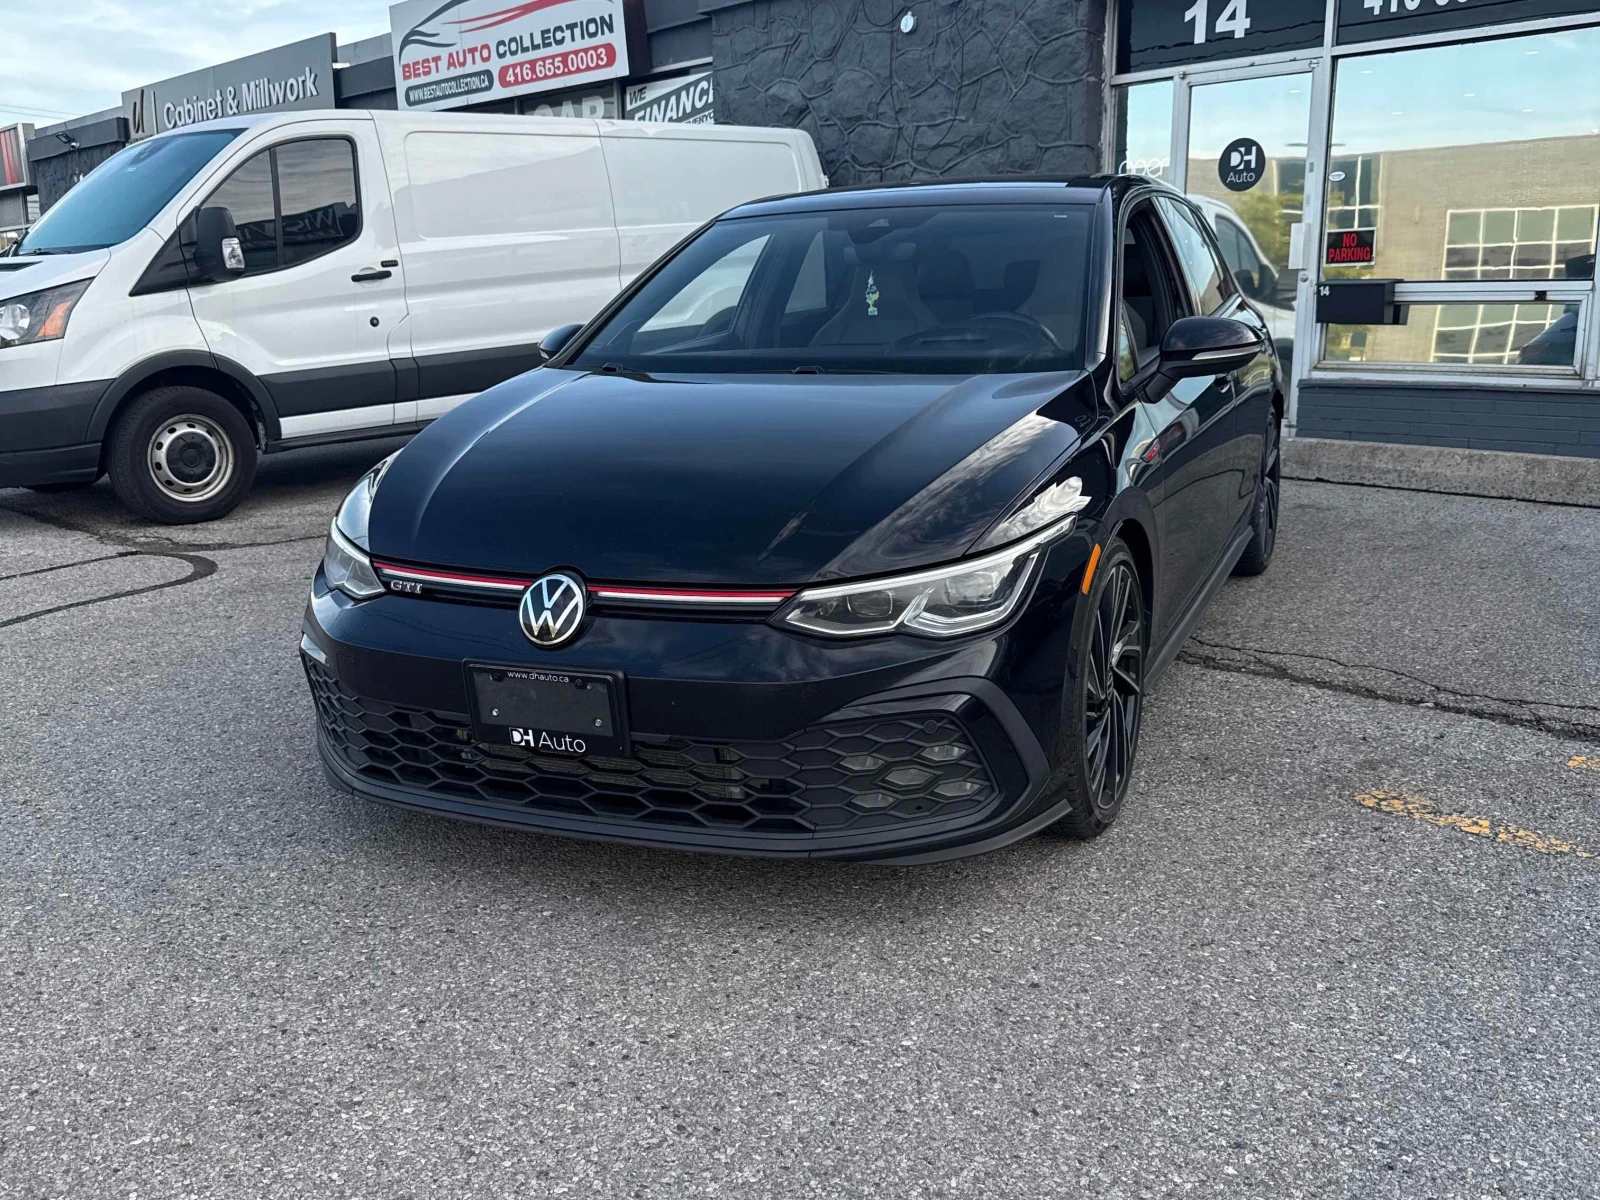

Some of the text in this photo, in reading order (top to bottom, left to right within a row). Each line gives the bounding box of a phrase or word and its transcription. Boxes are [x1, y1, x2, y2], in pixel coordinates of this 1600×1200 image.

[1184, 0, 1251, 45] 14
[402, 13, 615, 81] BEST AUTO COLLECTION
[408, 74, 490, 103] WWW.BESTAUTOCOLLECTION.CA
[629, 86, 647, 106] WE
[163, 66, 319, 129] Cabinet & Millwork
[1226, 171, 1256, 184] Auto
[1342, 233, 1358, 247] NO
[1328, 247, 1371, 262] PARKING
[1319, 285, 1331, 297] 14
[390, 580, 423, 594] GTI
[507, 671, 570, 683] www.dhauto.ca
[538, 731, 587, 753] Auto
